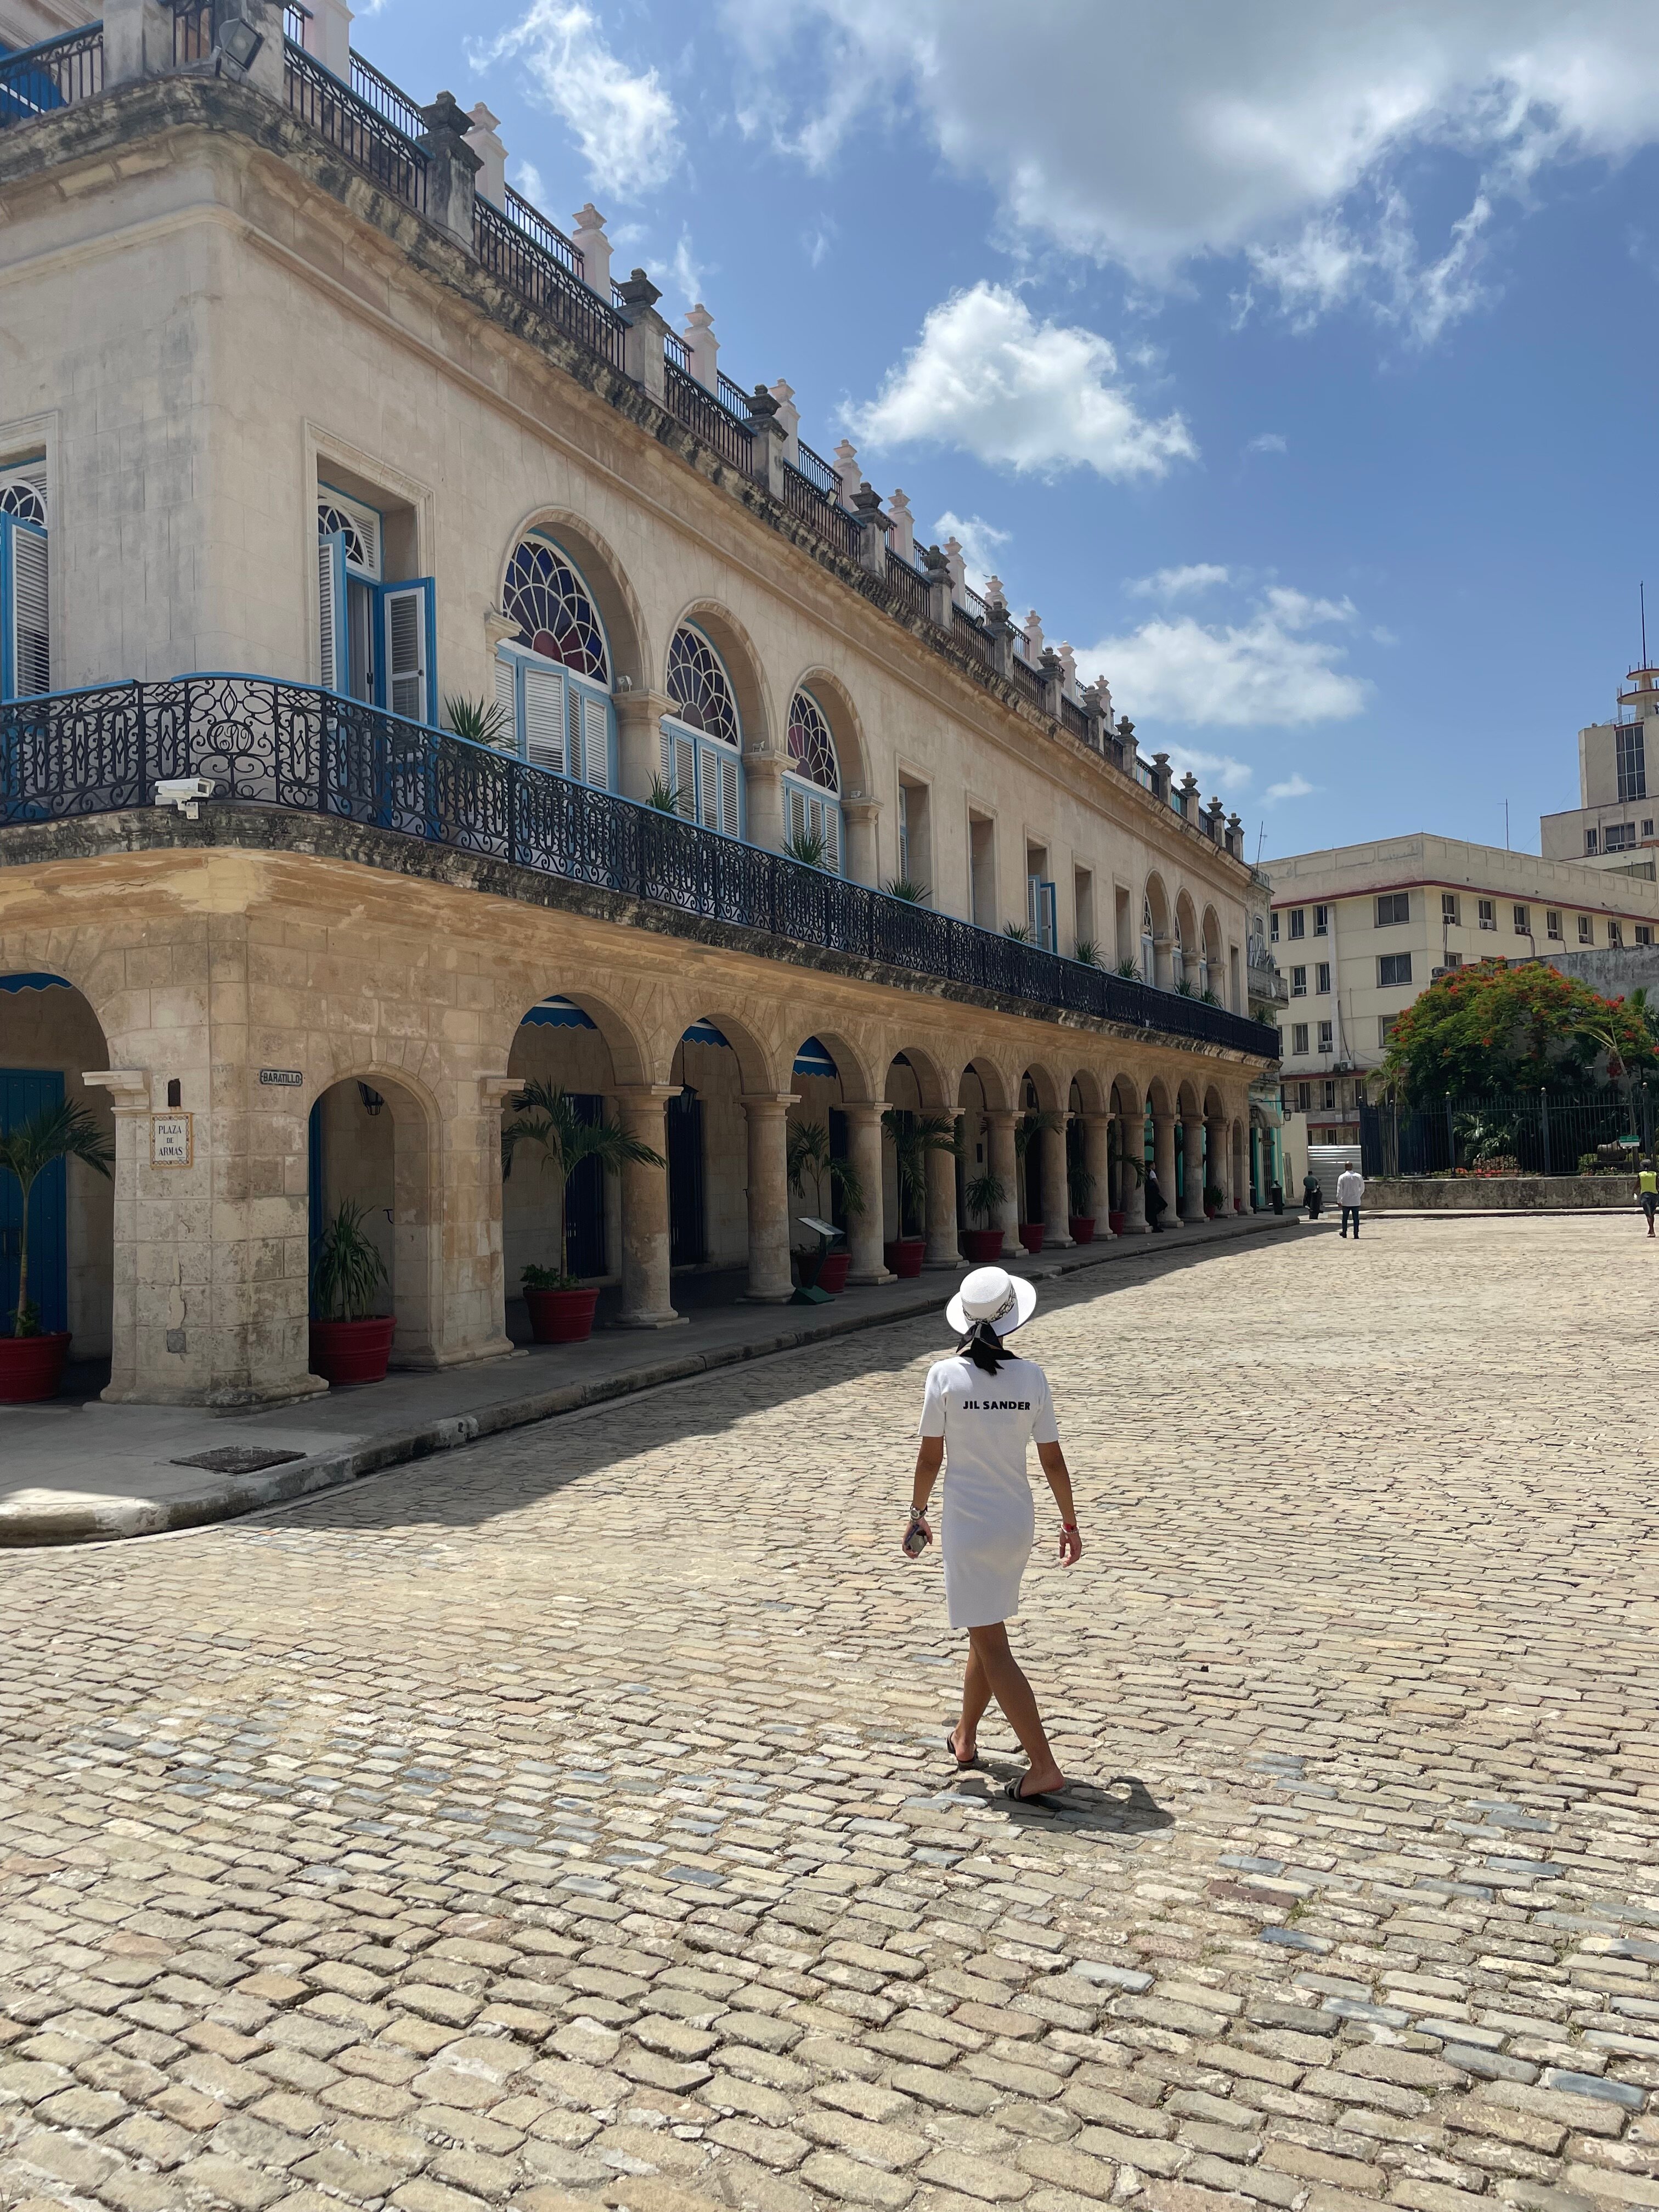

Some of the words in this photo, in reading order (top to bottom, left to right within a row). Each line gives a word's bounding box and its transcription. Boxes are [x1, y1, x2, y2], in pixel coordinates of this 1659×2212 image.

[263, 1073, 300, 1084] BARATILLO
[159, 1125, 182, 1135] PLAZA
[158, 1147, 183, 1156] ARMAS
[963, 1401, 980, 1409] JIL
[983, 1401, 1030, 1410] SANDER
